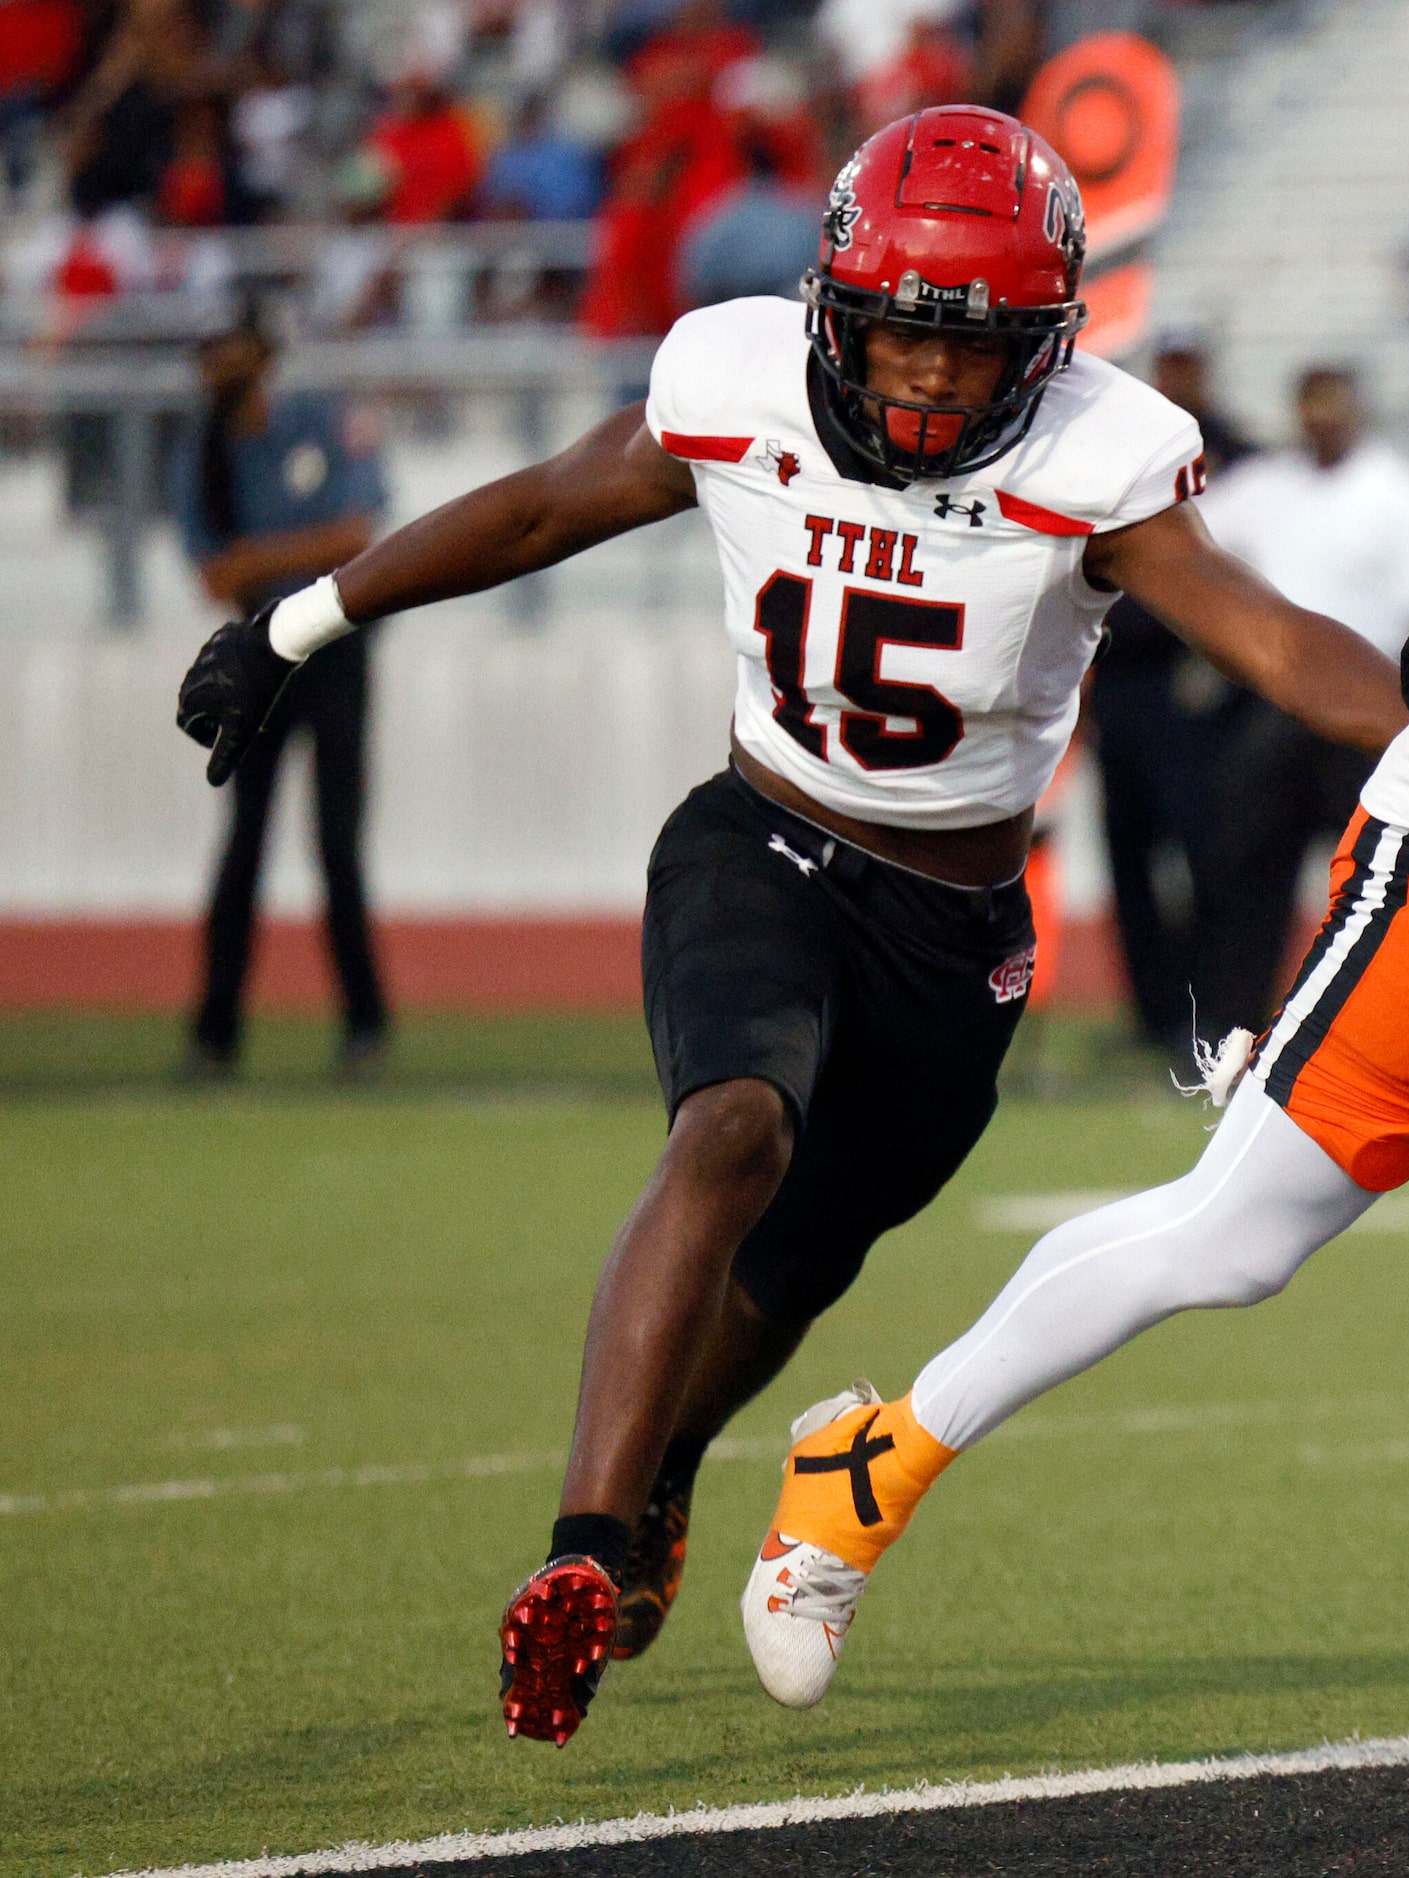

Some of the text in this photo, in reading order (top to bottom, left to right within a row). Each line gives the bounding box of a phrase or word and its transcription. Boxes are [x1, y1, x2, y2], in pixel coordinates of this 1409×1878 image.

[921, 282, 965, 300] TTHL
[805, 514, 924, 587] TTHL
[754, 569, 966, 771] 15
